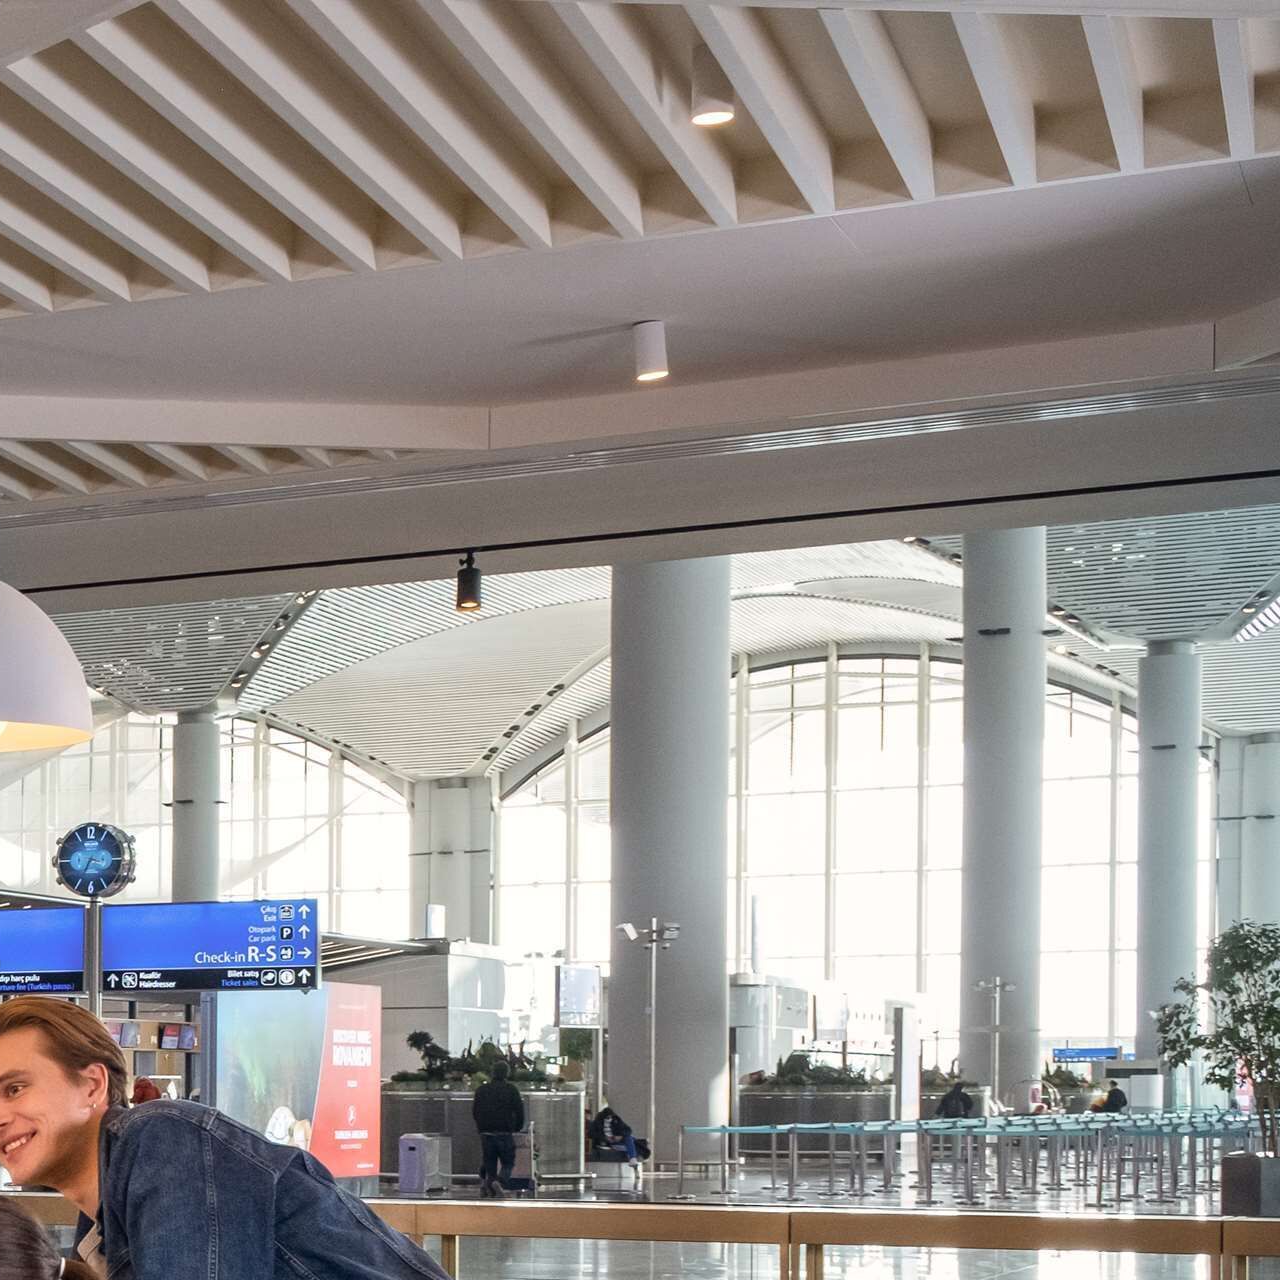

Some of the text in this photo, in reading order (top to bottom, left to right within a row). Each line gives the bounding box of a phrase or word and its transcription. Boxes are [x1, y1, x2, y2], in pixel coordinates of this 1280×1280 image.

[87, 826, 95, 839] 12
[87, 881, 94, 894] 6
[263, 914, 277, 922] Exit
[248, 925, 276, 934] Otopark
[261, 934, 276, 943] park
[194, 945, 277, 964] Check-in R-S
[139, 980, 176, 988] Hairdresser
